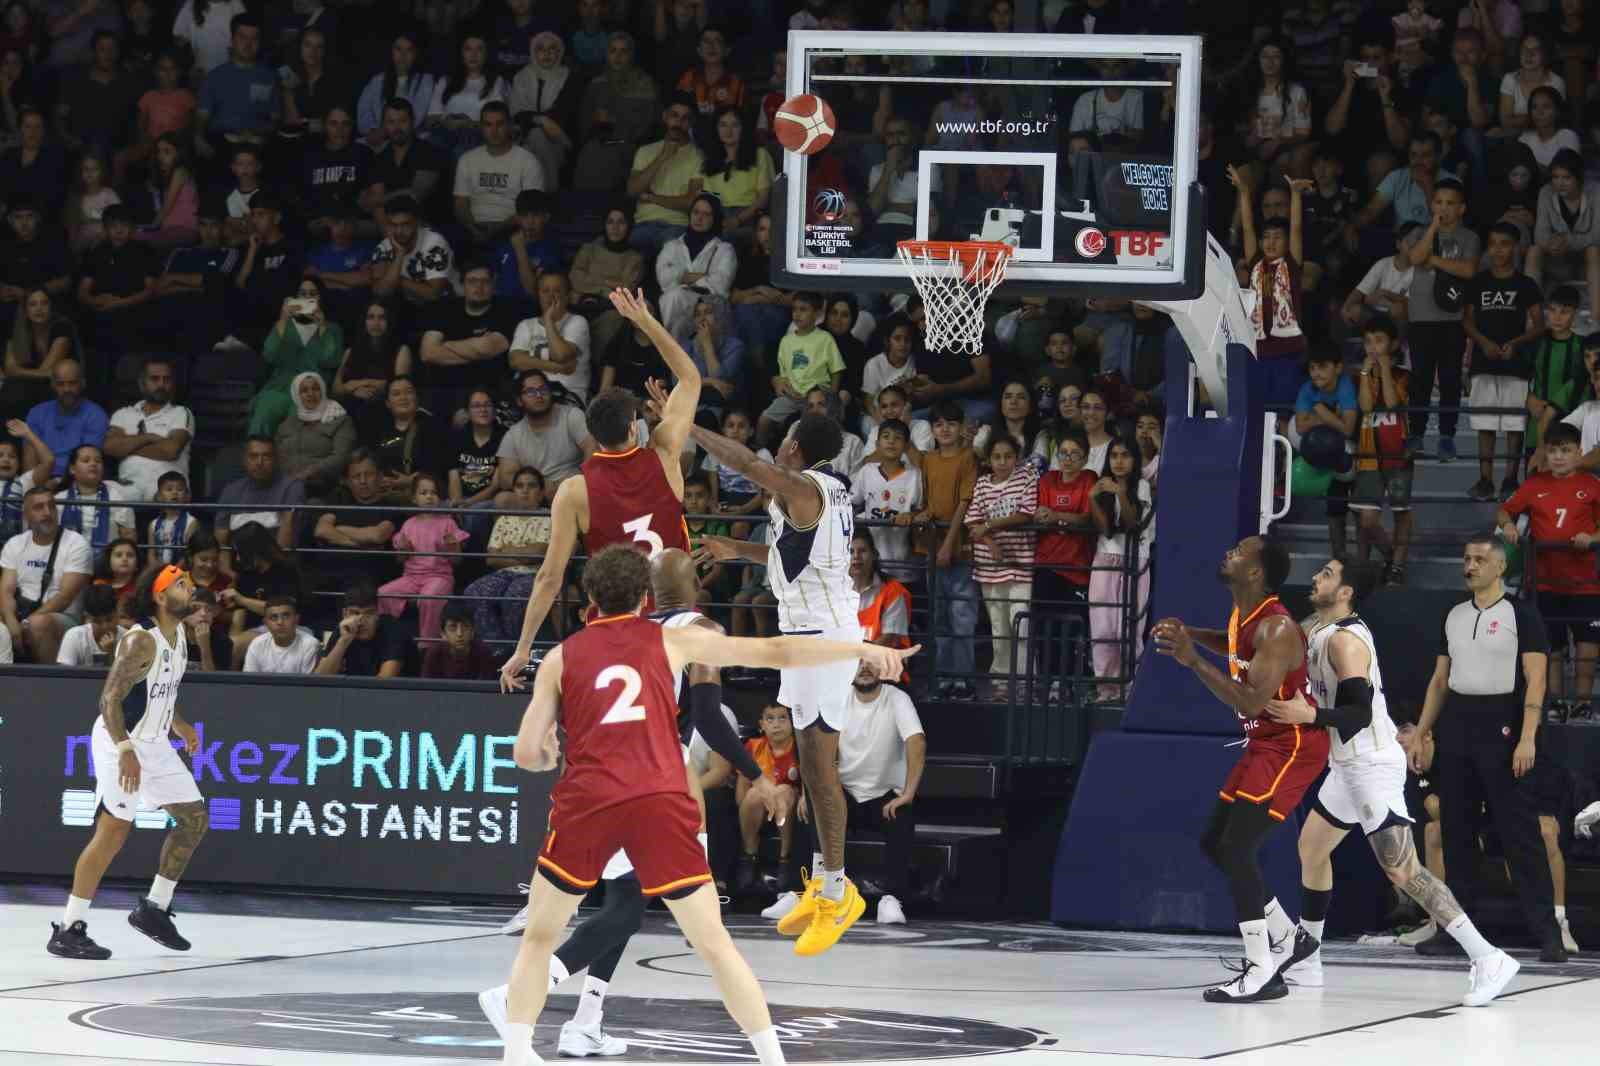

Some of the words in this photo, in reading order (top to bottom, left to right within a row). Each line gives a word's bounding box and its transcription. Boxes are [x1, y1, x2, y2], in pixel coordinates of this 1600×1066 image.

[936, 120, 1049, 135] www.tbf.org.tr
[1121, 163, 1166, 188] WELCOME
[1141, 188, 1169, 210] HOME
[805, 239, 853, 248] BASKETBOL
[1109, 230, 1166, 256] TBF
[1481, 291, 1518, 306] EA7
[1556, 508, 1567, 528] 7
[622, 513, 664, 560] 3
[595, 664, 647, 725] 2
[254, 798, 519, 845] HASTANESİ
